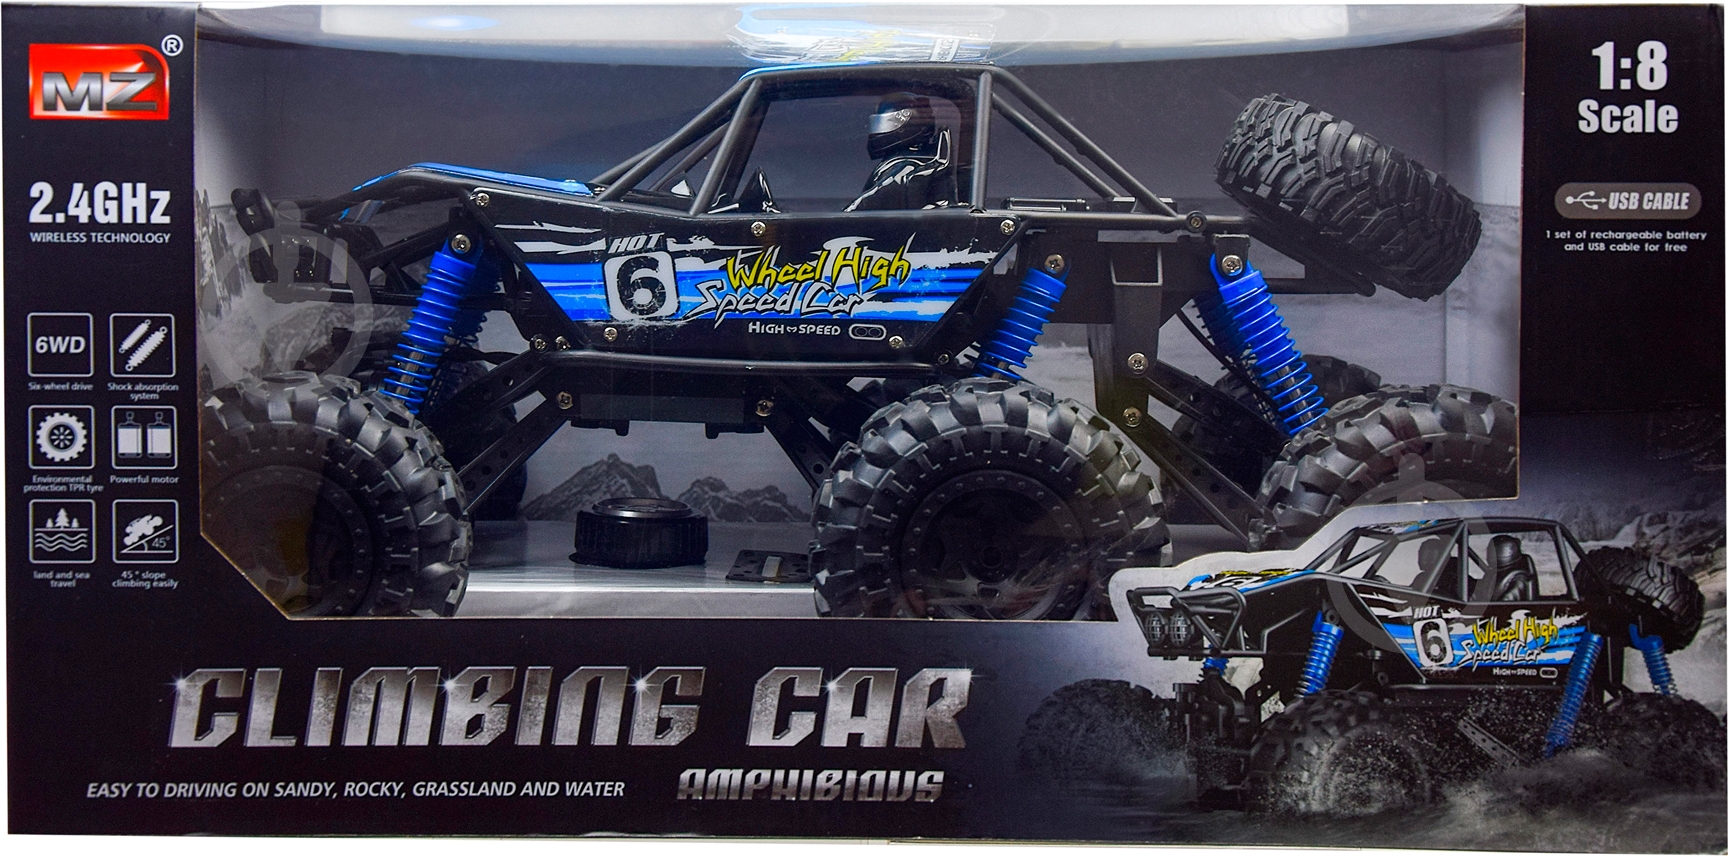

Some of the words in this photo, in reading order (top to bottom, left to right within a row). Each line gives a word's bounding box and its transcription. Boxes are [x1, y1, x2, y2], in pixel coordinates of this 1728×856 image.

[1591, 40, 1668, 91] 1:8
[42, 71, 157, 112] MZ
[1578, 98, 1679, 134] Scale
[28, 181, 171, 224] 2.4GHz
[1608, 192, 1640, 210] USB
[1642, 192, 1690, 210] CABLE
[30, 232, 88, 243] WIRELESS
[90, 232, 171, 244] TECHNOLOGY
[607, 233, 664, 253] HOT
[1546, 230, 1551, 239] 1
[1554, 230, 1571, 239] set
[1575, 230, 1587, 239] of
[1590, 230, 1663, 240] rechargeable
[1666, 230, 1708, 241] battery
[1564, 243, 1585, 252] and
[1588, 243, 1606, 252] USB
[1609, 243, 1641, 252] cable
[1644, 243, 1660, 252] for
[1664, 243, 1688, 252] free
[726, 248, 825, 289] Wheel
[831, 243, 911, 290] High
[616, 255, 667, 316] 6
[686, 280, 800, 327] Speed
[801, 280, 876, 317] Car
[35, 336, 86, 354] 6WD
[28, 382, 70, 391] Six-wheel
[71, 382, 93, 391] drive
[107, 382, 132, 391] Shock
[134, 382, 179, 392] absorption
[130, 393, 159, 402] system
[32, 475, 92, 483] Environmental
[110, 475, 149, 483] Powerful
[23, 484, 66, 493] protection
[87, 484, 104, 493] tyre
[33, 571, 53, 579] land
[55, 571, 73, 579] and
[141, 571, 166, 581] slope
[112, 580, 150, 589] climbing
[152, 580, 179, 589] easily
[1413, 605, 1440, 618] HOT
[1472, 619, 1520, 646] Wheel
[1523, 616, 1559, 645] High
[1420, 621, 1447, 664] 6
[1458, 639, 1512, 672] Speed
[168, 666, 706, 748] CLIMBING
[746, 667, 972, 748] CAR
[86, 783, 133, 798] EASY
[136, 783, 160, 798] TO
[163, 783, 238, 798] DRIVING
[241, 783, 270, 798] ON
[273, 782, 338, 799] SANDY,
[343, 782, 406, 799] ROCKY,
[412, 782, 516, 797] GRASSLAND
[519, 782, 560, 797] AND
[564, 782, 626, 797] WATER
[676, 768, 945, 802] AMPHIBIOUS
